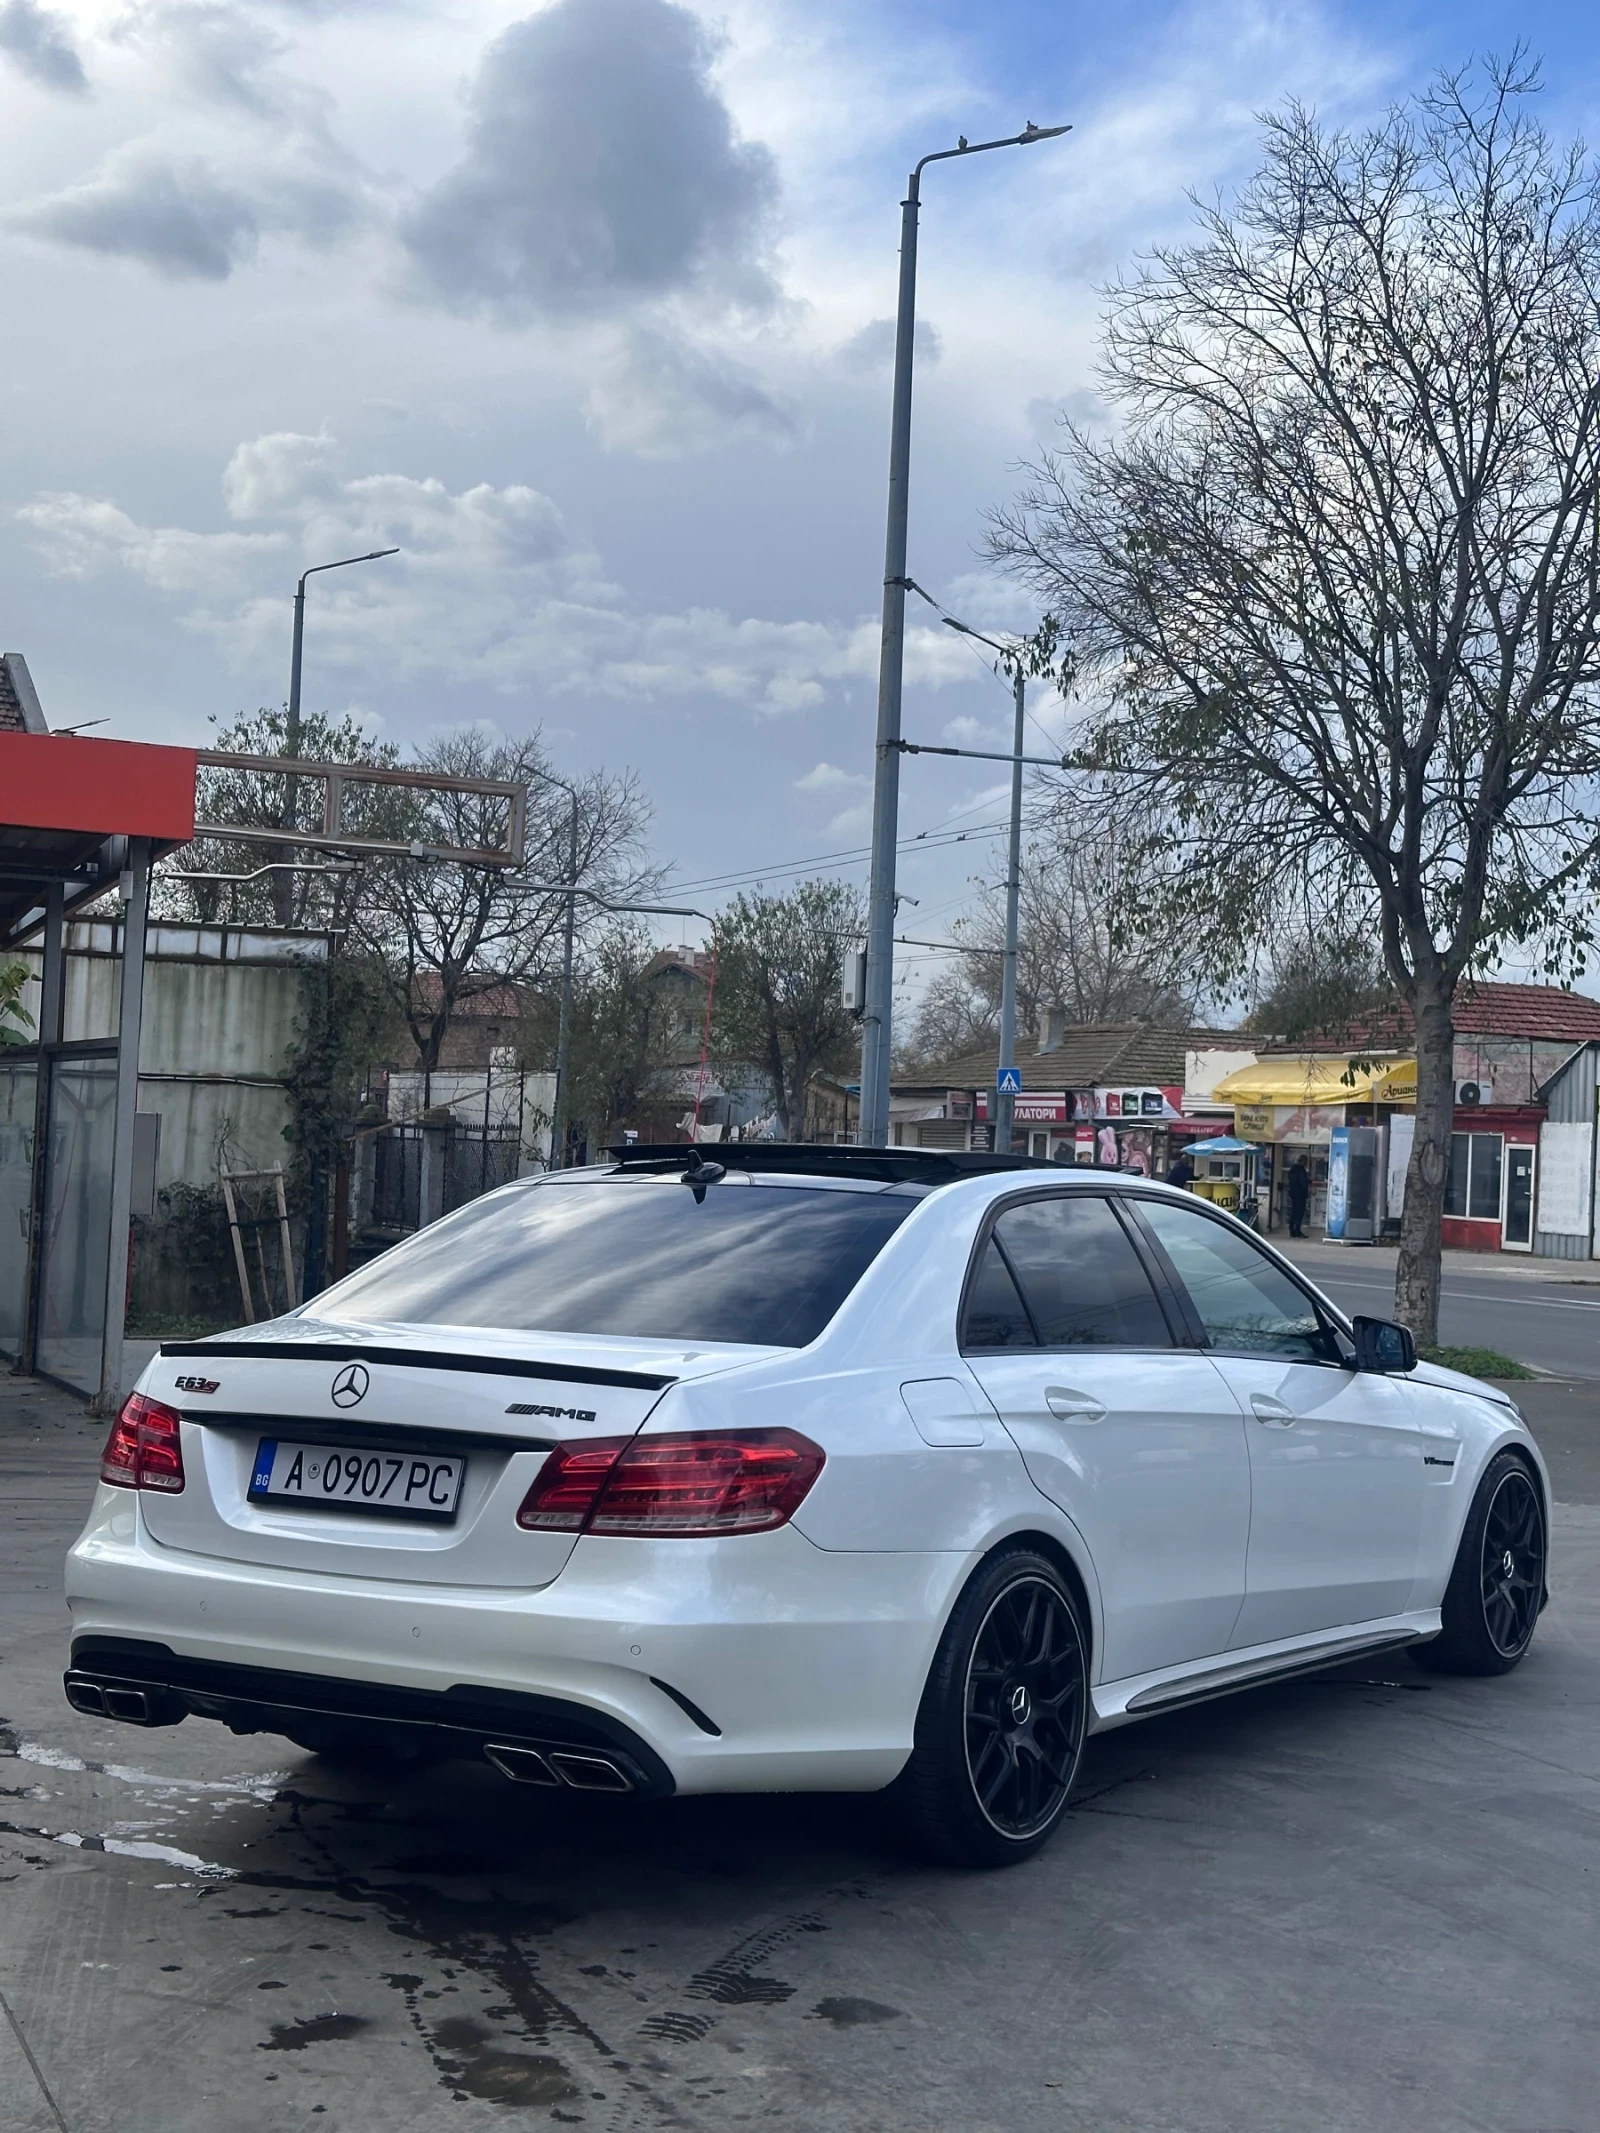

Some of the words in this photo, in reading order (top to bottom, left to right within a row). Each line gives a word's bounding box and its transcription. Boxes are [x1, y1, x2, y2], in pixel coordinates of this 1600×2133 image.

[534, 1405, 597, 1422] AMG
[255, 1473, 270, 1487] BG
[322, 1453, 404, 1498] 0907
